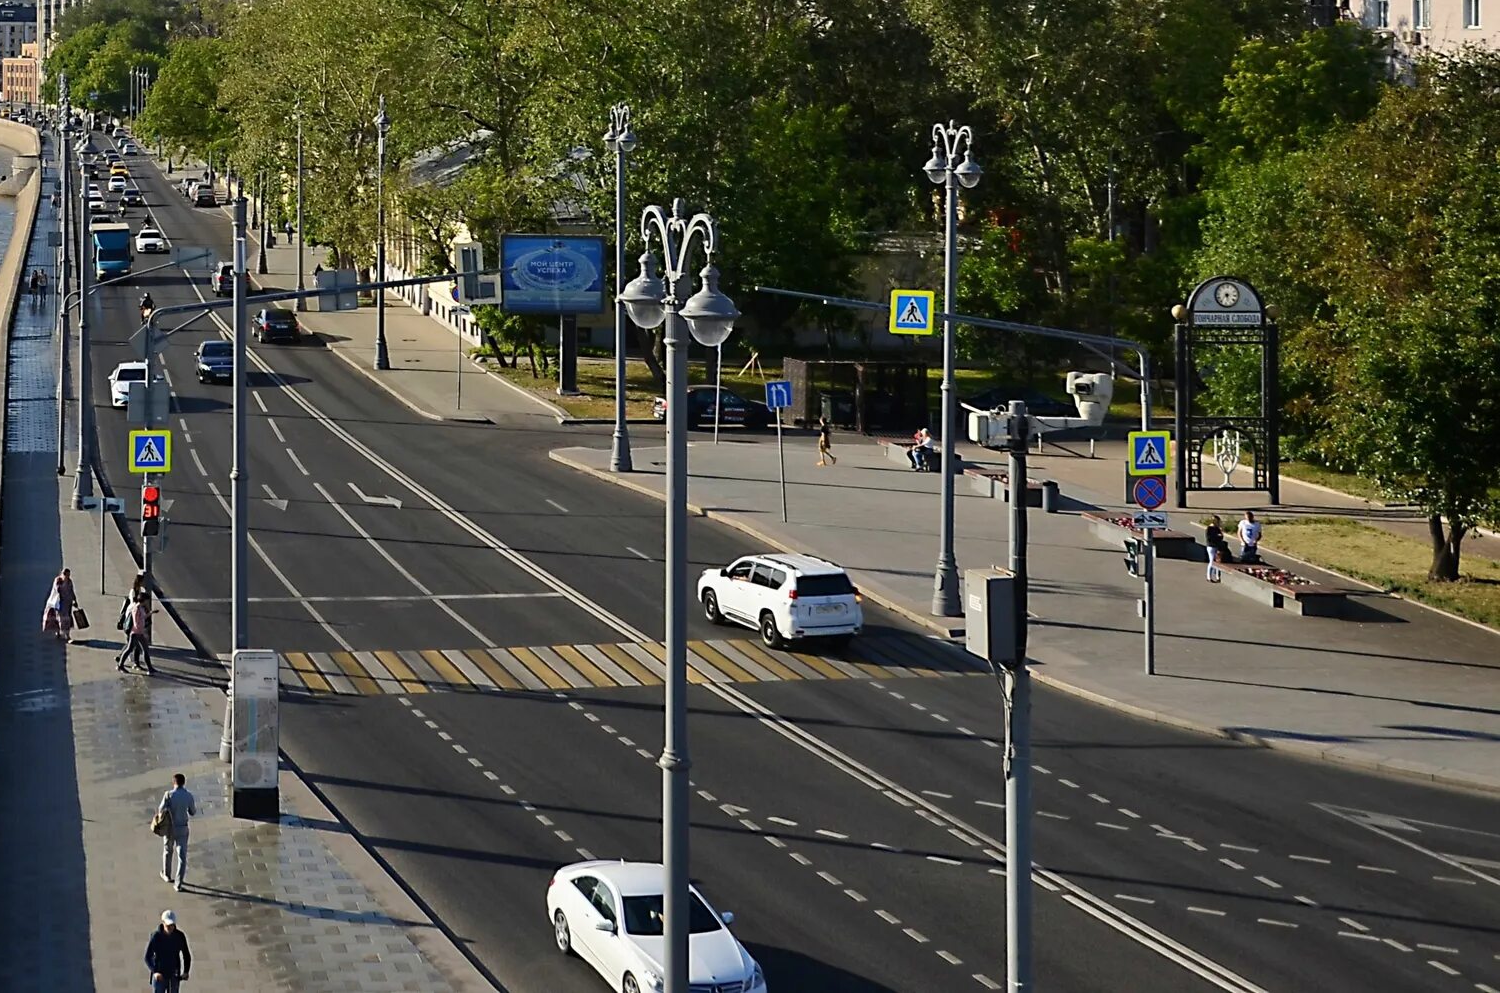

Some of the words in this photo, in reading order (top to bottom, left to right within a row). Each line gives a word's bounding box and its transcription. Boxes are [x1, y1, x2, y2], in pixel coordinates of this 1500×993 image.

[1195, 314, 1230, 323] ГОНЧАРНАЯ
[1232, 314, 1260, 323] СЛОБОДА
[145, 505, 157, 517] 31
